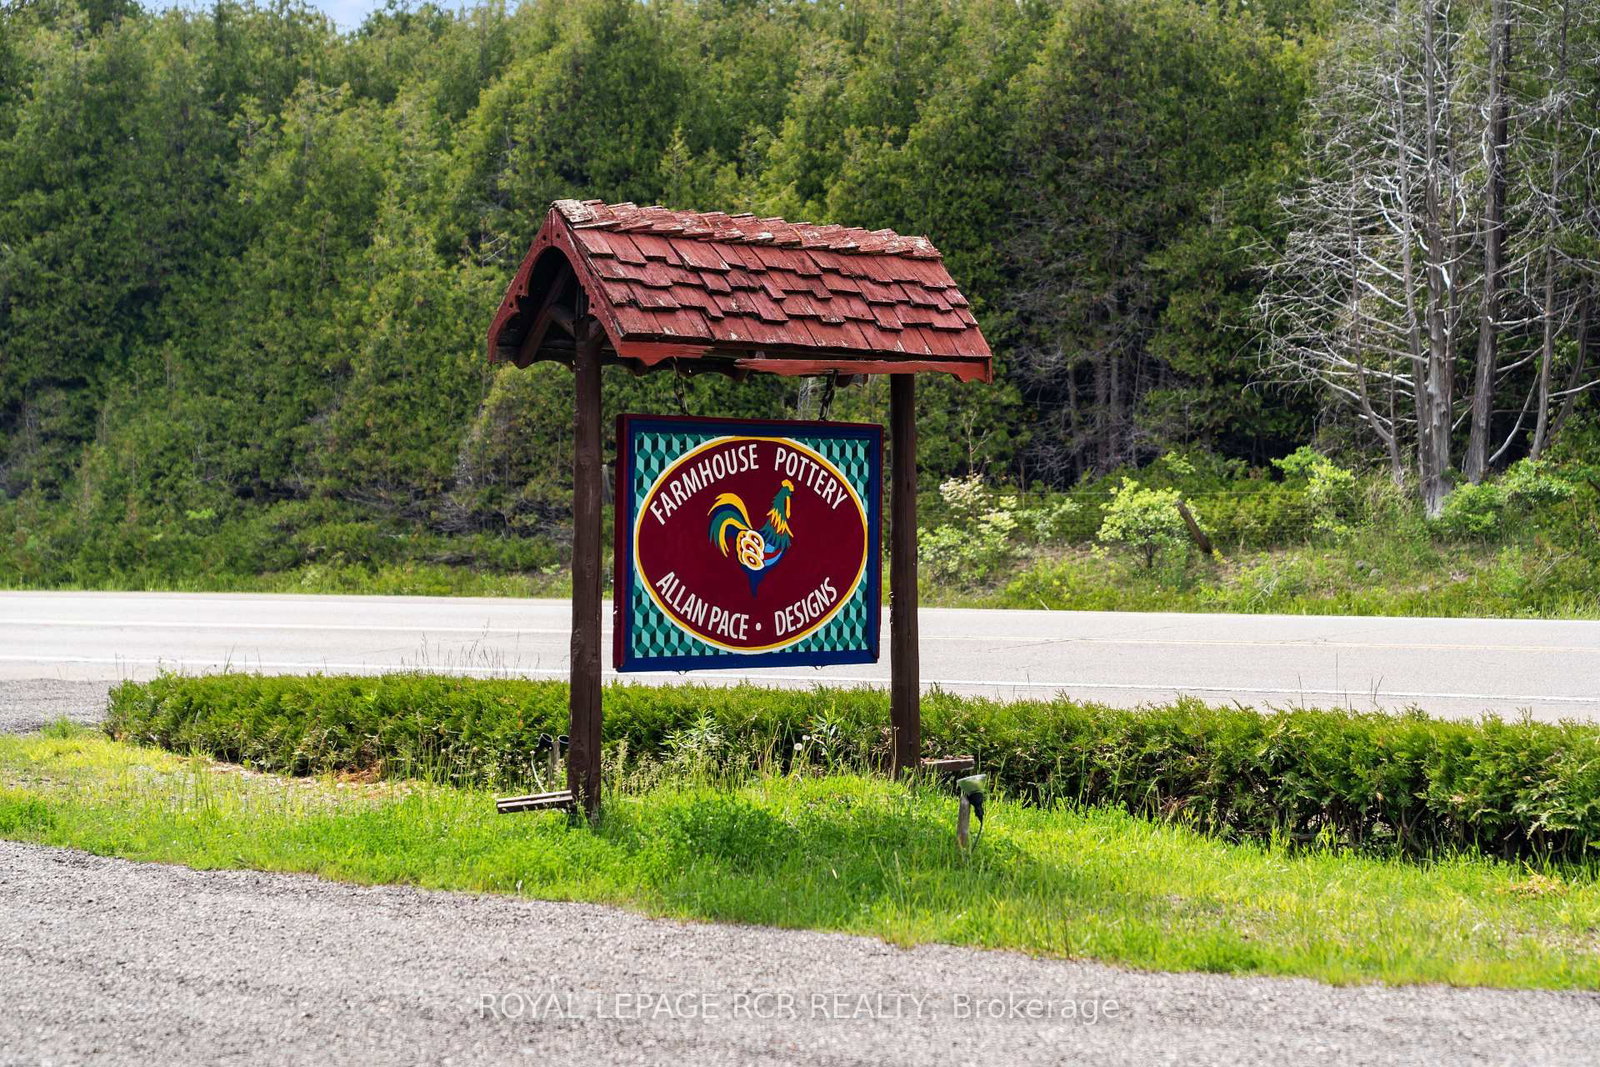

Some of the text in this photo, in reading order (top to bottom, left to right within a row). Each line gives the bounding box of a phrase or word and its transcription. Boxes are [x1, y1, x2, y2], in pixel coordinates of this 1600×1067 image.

[650, 443, 848, 525] FARMHOUSE POTTERY
[655, 571, 838, 640] ALLAN PACE DESIGNS
